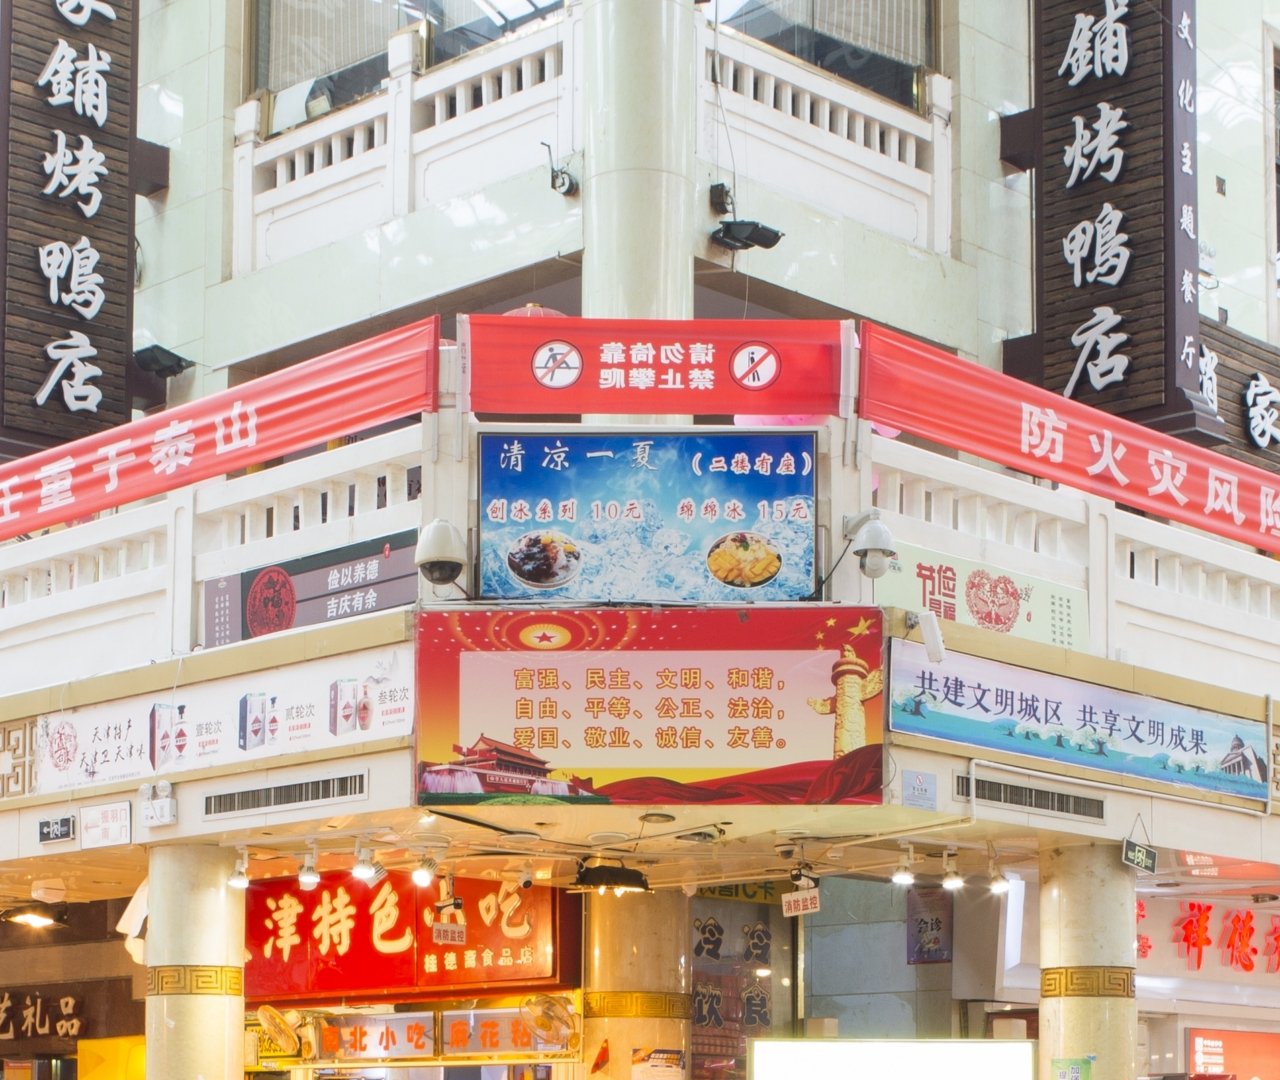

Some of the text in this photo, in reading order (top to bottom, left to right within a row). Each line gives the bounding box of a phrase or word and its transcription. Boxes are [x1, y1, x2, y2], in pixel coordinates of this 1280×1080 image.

[500, 440, 658, 472] 清凉一夏
[487, 498, 811, 522] 刨冰系列 10元 绵绵冰 15元
[327, 559, 380, 590] 俭以养德
[326, 588, 378, 618] 吉庆有余
[914, 670, 1208, 757] 共建文明城区 共享文明成果
[784, 896, 819, 914] 消防监控
[242, 879, 533, 962] 津特色小吃
[435, 927, 466, 943] 消防监控
